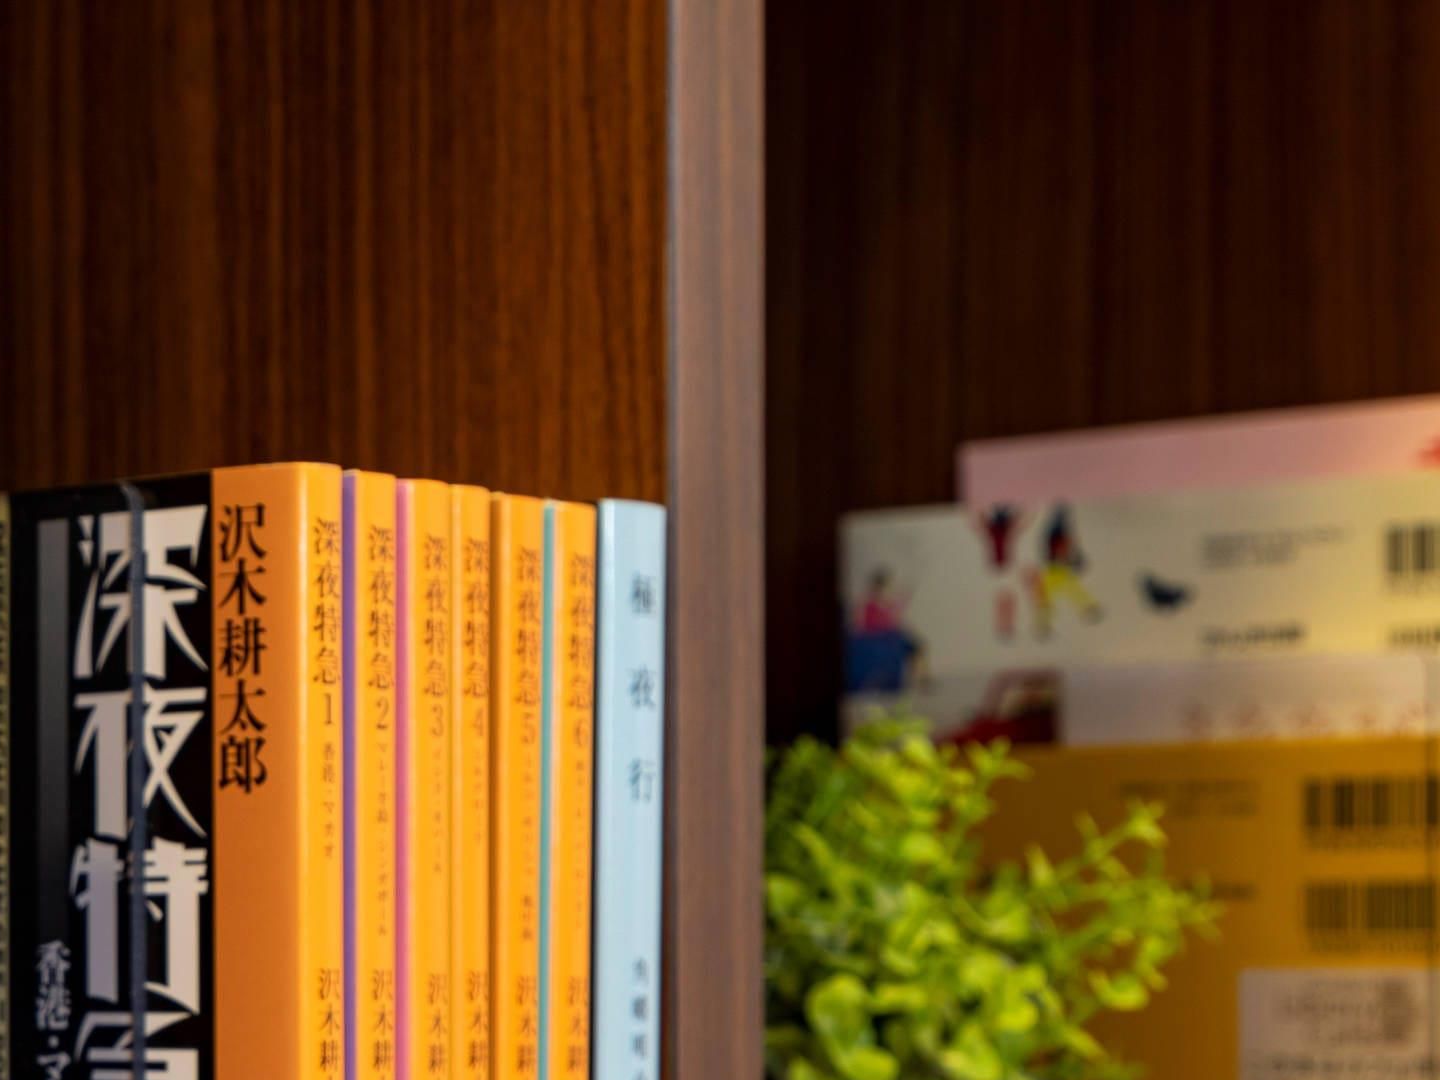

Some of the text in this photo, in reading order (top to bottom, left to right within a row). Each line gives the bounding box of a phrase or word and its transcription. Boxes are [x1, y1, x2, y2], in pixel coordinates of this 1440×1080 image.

[218, 502, 267, 795] 沢木耕太郎
